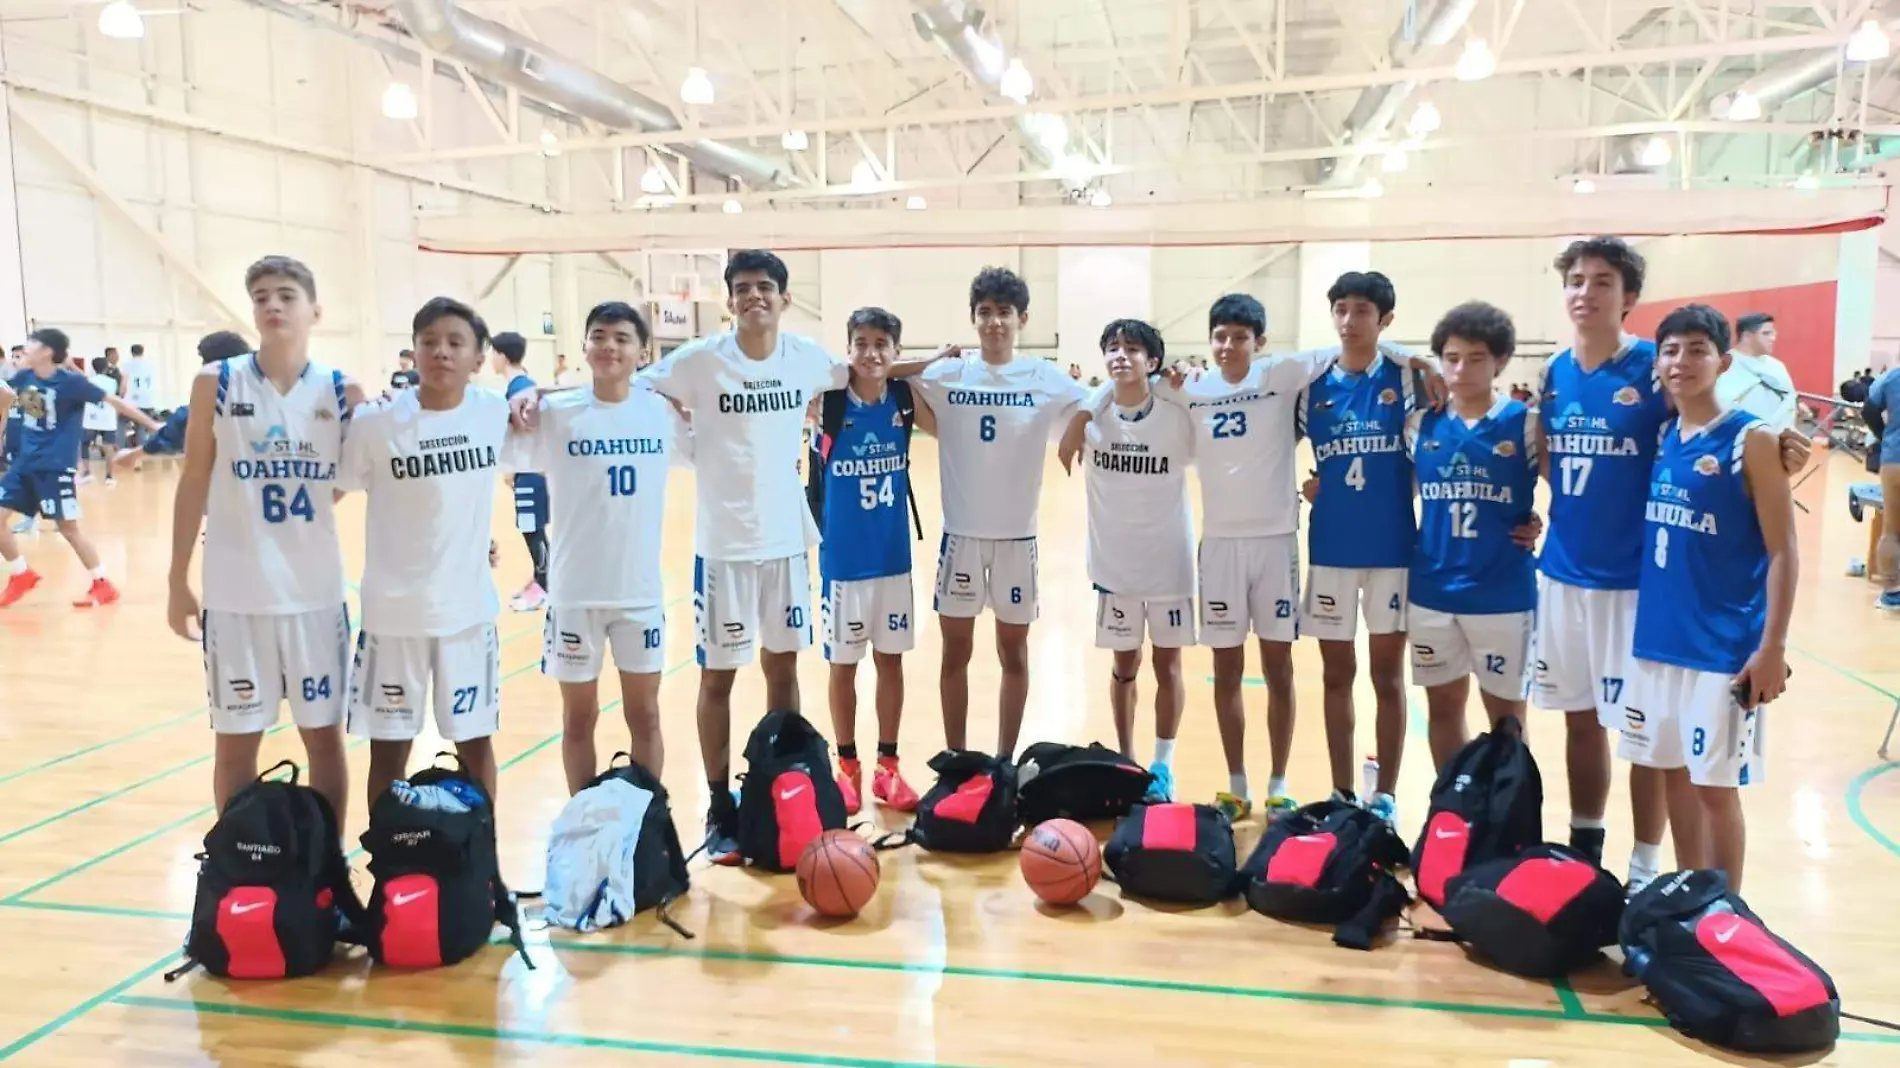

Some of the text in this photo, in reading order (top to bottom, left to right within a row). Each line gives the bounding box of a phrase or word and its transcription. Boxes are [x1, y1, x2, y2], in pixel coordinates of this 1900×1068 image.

[719, 389, 802, 413] COAHUILA
[947, 391, 1034, 407] COAHUILA
[980, 414, 996, 442] 6
[1212, 411, 1247, 439] 23
[274, 439, 316, 453] STHL
[568, 438, 663, 456] COAHUILA
[391, 446, 496, 479] COAHUILA
[1093, 449, 1169, 474] COAHUILA
[1345, 456, 1366, 491] 4
[608, 465, 636, 496] 10
[1560, 456, 1593, 497] 17
[262, 483, 315, 523] 64
[860, 475, 894, 510] 54
[1421, 481, 1512, 504] COAHUILA
[1448, 501, 1478, 538] 12
[1011, 586, 1021, 604] 6
[1389, 593, 1400, 611] 4
[888, 613, 908, 631] 54
[1168, 608, 1181, 627] 11
[643, 628, 660, 649] 10
[1485, 653, 1505, 675] 12
[302, 674, 332, 702] 64
[452, 685, 478, 715] 27
[1601, 676, 1624, 704] 17
[1692, 727, 1706, 756] 8
